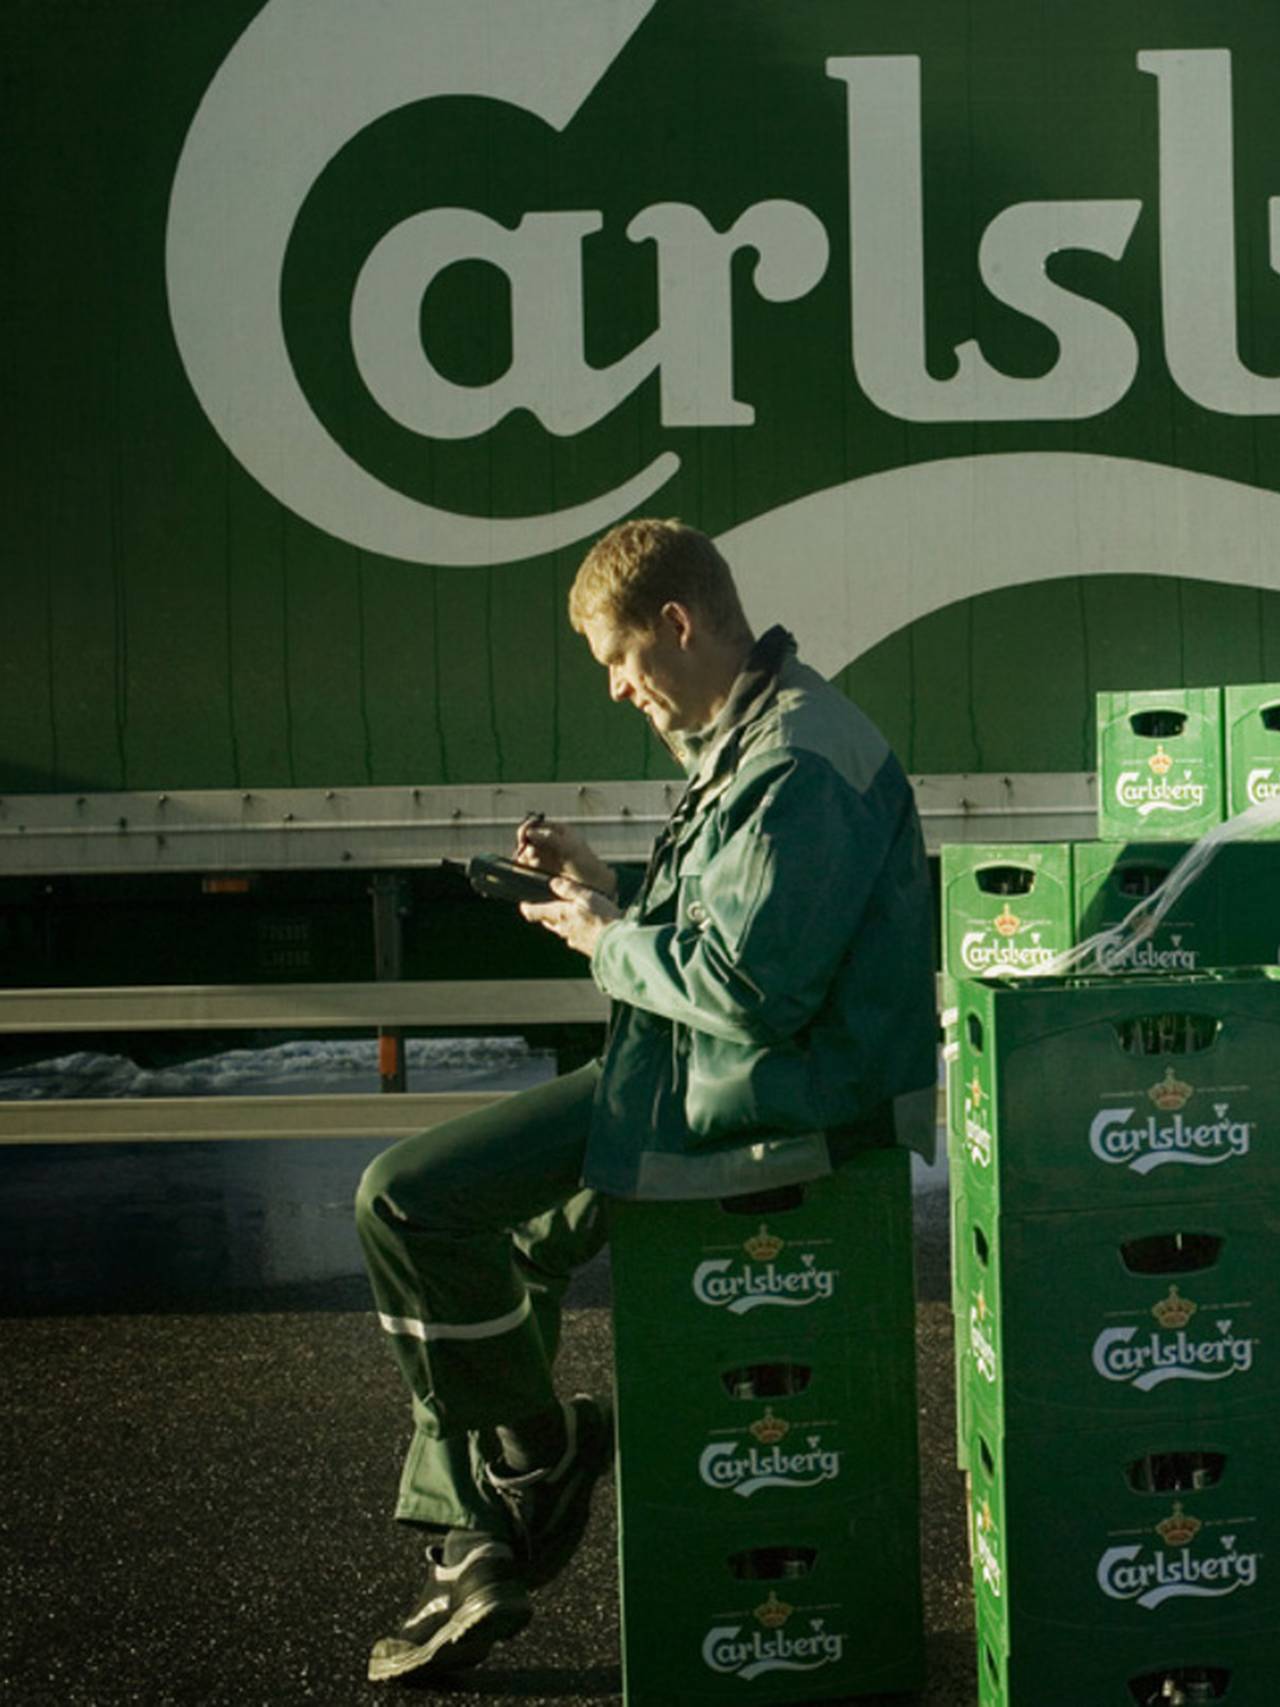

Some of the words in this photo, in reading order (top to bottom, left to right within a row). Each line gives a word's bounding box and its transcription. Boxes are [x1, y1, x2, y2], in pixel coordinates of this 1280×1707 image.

[1116, 769, 1204, 815] Carlsberg
[1089, 1103, 1250, 1175] Carlsberg
[693, 1254, 835, 1314] Carlsberg
[1092, 1319, 1252, 1392] Carlsberg
[699, 1435, 840, 1497] Carlsberg
[1097, 1535, 1257, 1610] Carlsberg
[702, 1619, 842, 1680] Carlsberg
